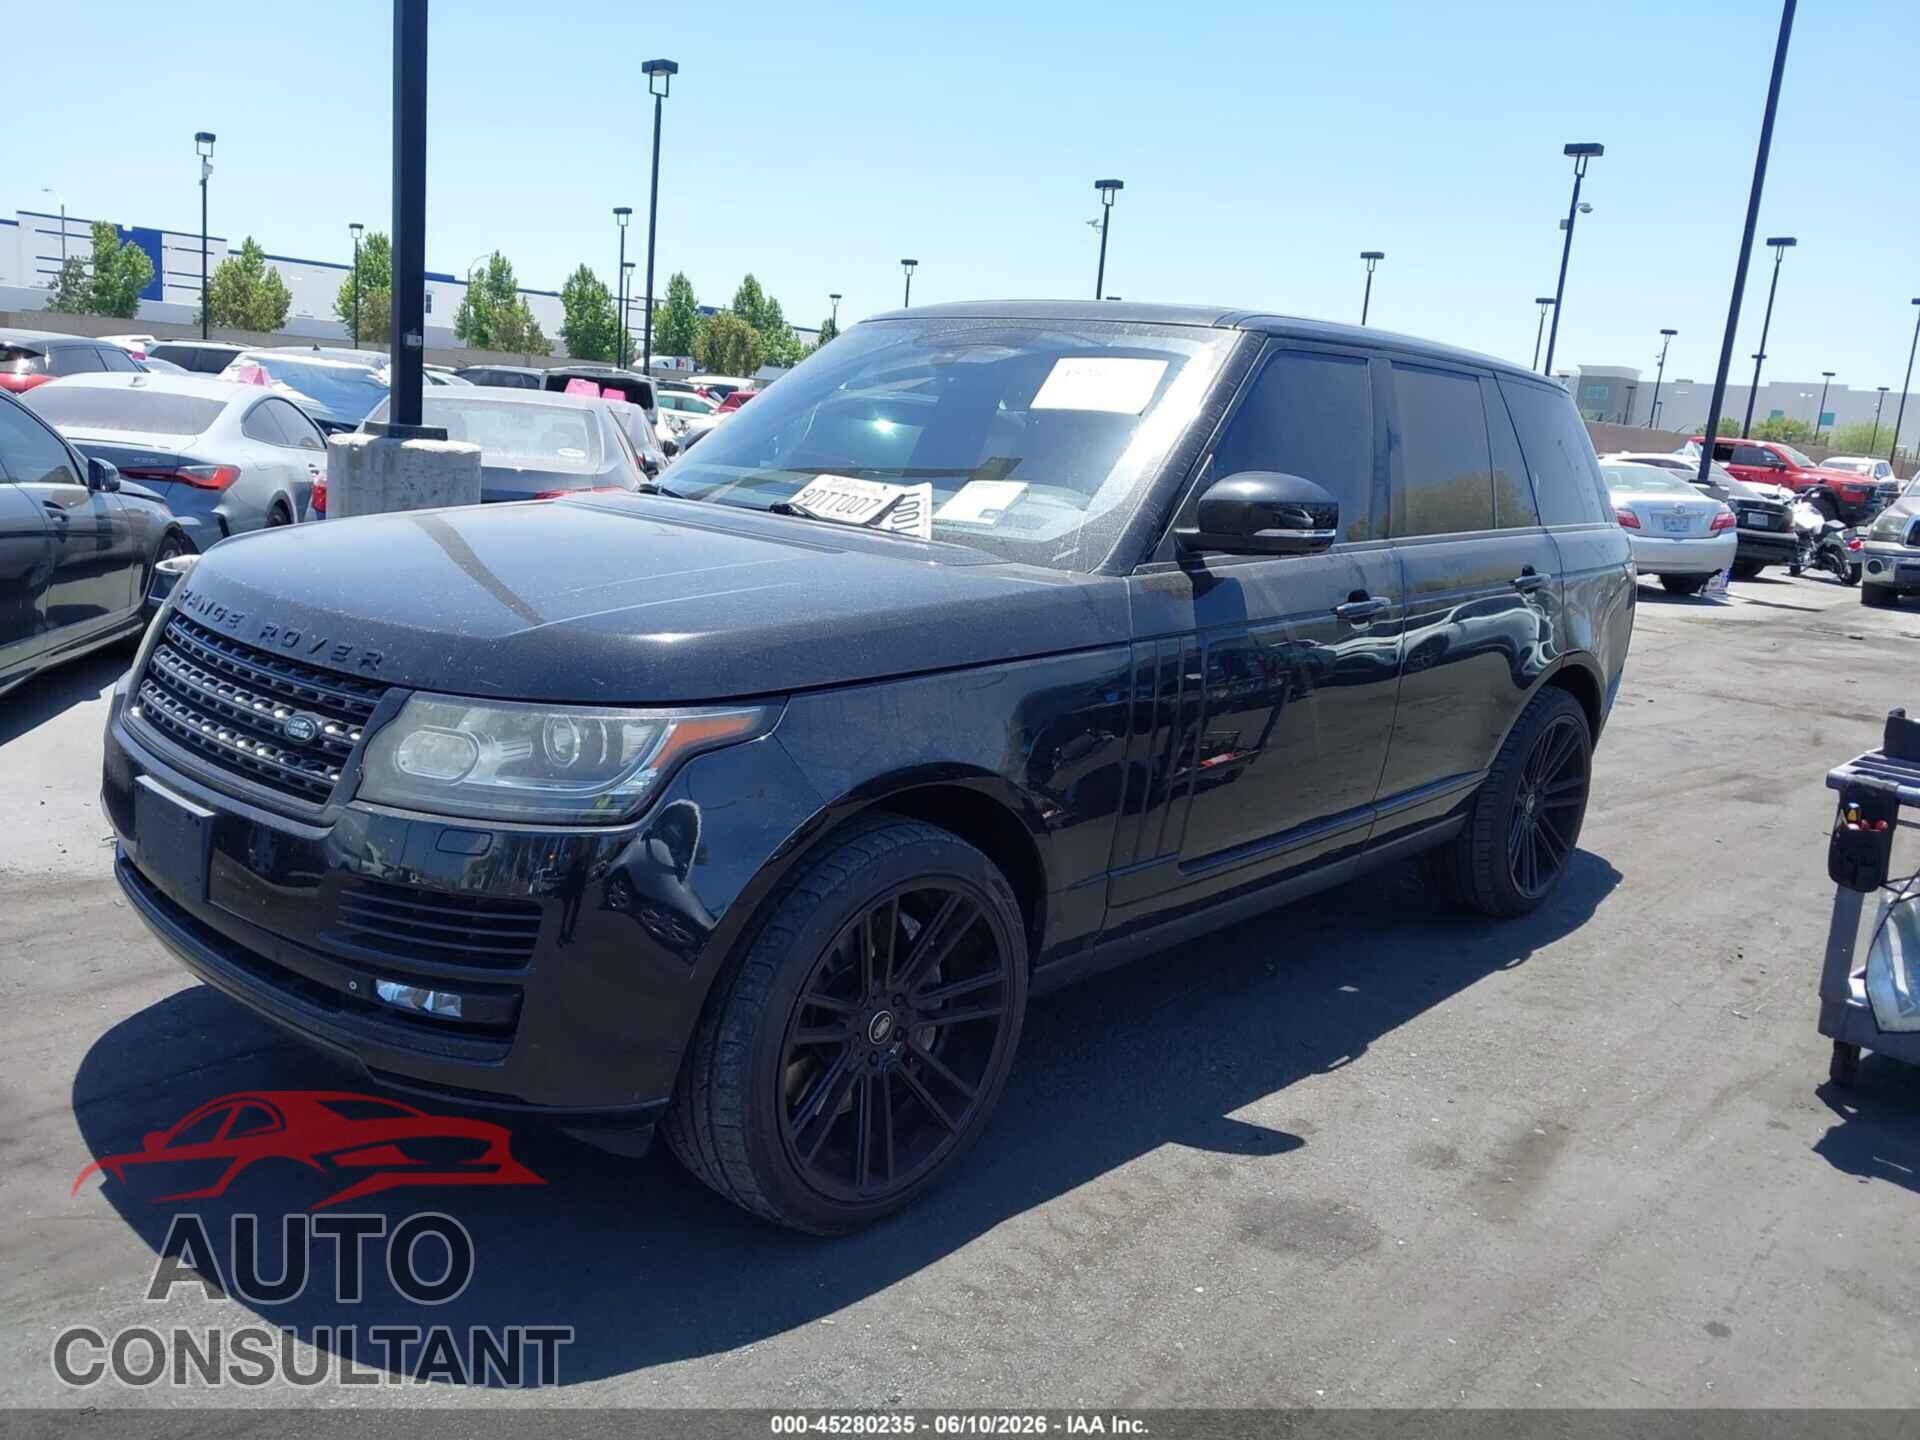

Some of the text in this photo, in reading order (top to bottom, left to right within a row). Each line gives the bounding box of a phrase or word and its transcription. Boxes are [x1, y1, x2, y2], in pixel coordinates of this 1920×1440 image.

[799, 488, 882, 515] 9DTT007
[179, 588, 384, 671] RANGE ROVER
